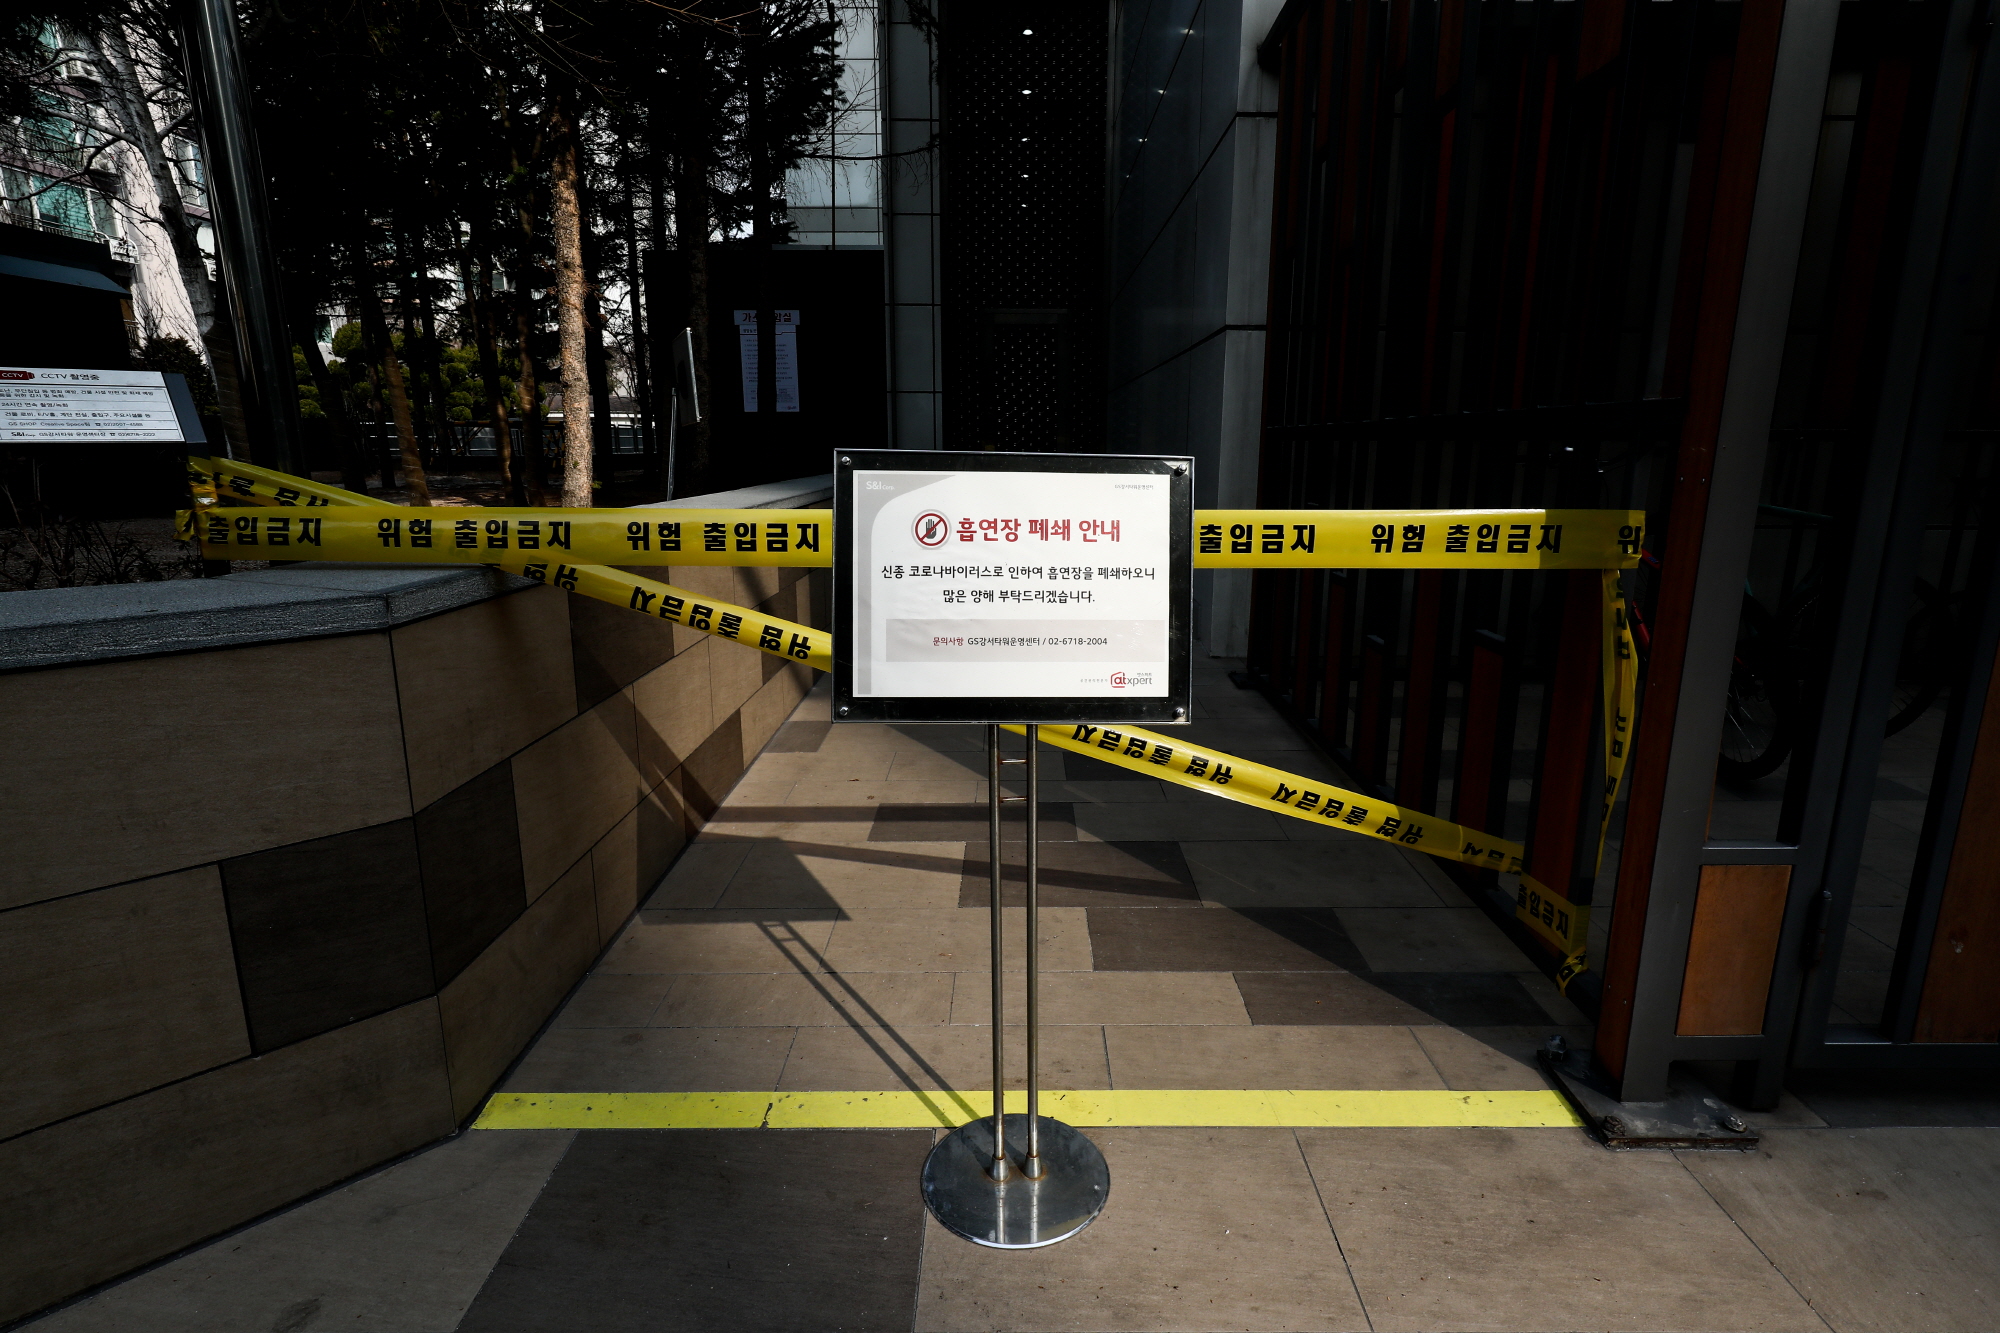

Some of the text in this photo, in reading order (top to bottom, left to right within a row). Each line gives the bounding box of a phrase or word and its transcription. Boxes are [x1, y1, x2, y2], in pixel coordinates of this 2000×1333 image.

[70, 373, 100, 381] 촬영중
[866, 480, 882, 490] S&I
[208, 516, 322, 547] 출입금지
[377, 518, 572, 550] 위험 출입금지
[626, 521, 820, 553] 위험 출입금지
[956, 517, 1121, 543] 흡연장 폐쇄 안내
[1198, 523, 1317, 554] 출입금지
[1370, 523, 1563, 554] 위험 출입금지
[881, 565, 1155, 580] 신종 코로나바이러스로 인하여 흡연장을 폐쇄하오니
[943, 589, 1096, 604] 많은 양해 부탁드리겠습니다.
[629, 586, 812, 660] 위험 출입금지
[932, 636, 964, 647] 문의사항
[967, 636, 1041, 647] GS강서타워운영센터
[1048, 636, 1108, 646] 02-6718-2004
[1071, 725, 1234, 785] 위험 출입금지
[1270, 782, 1424, 845] 위험 출입금지
[1517, 883, 1569, 940] 출입금지
